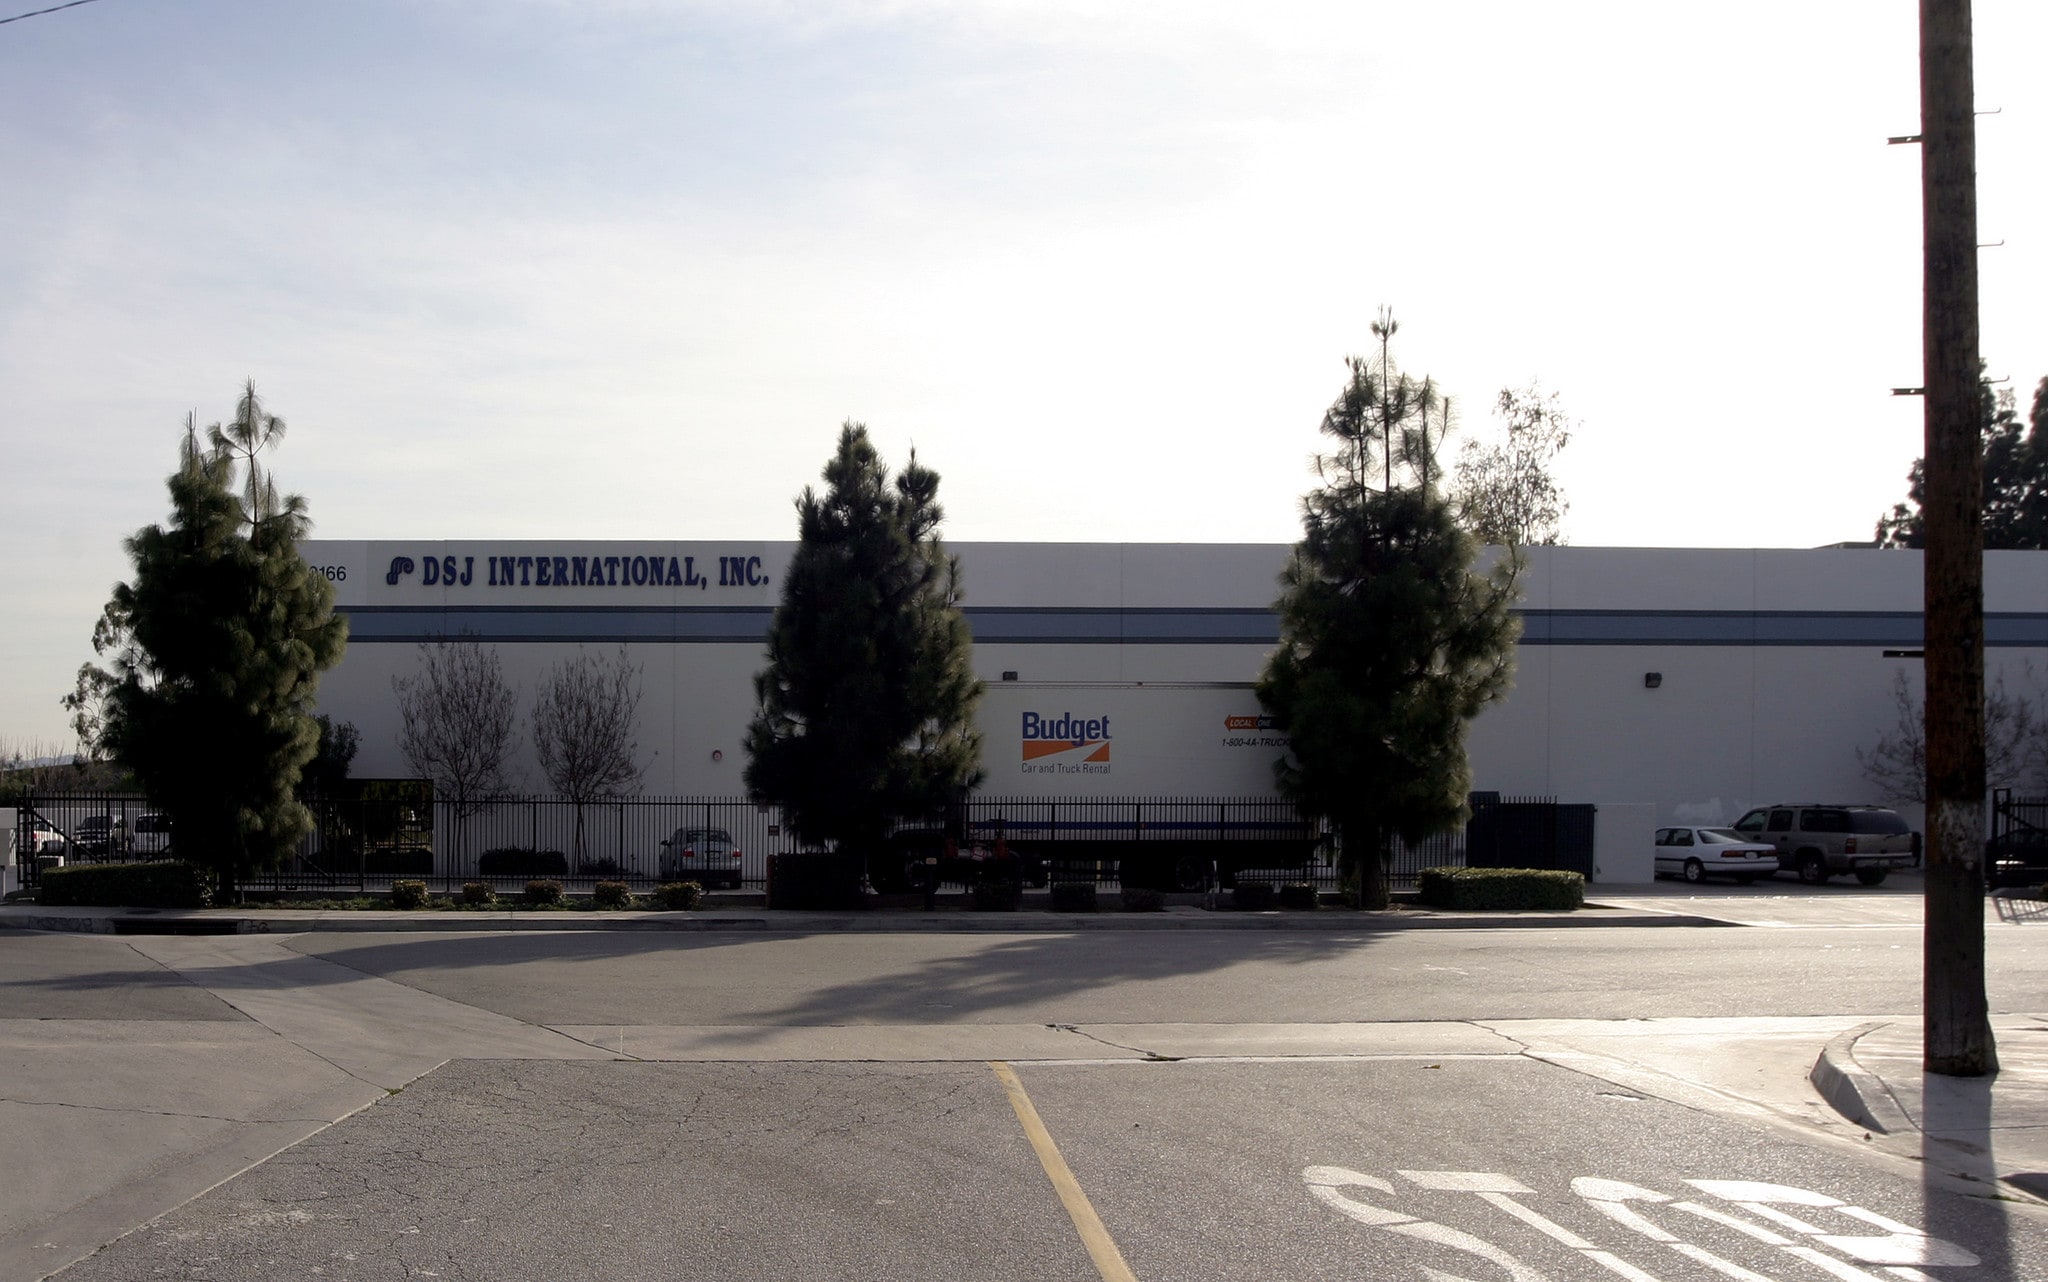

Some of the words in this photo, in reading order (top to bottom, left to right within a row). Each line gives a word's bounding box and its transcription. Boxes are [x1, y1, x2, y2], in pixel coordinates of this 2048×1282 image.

[423, 556, 474, 586] DSJ
[488, 556, 707, 591] INTERNATIONAL,
[719, 556, 770, 586] INC.
[1022, 711, 1111, 747] Budget
[1229, 719, 1252, 727] LOCAL
[1021, 763, 1037, 774] Car
[1039, 763, 1055, 774] and
[1057, 763, 1081, 774] Truck
[1083, 763, 1111, 775] Rental
